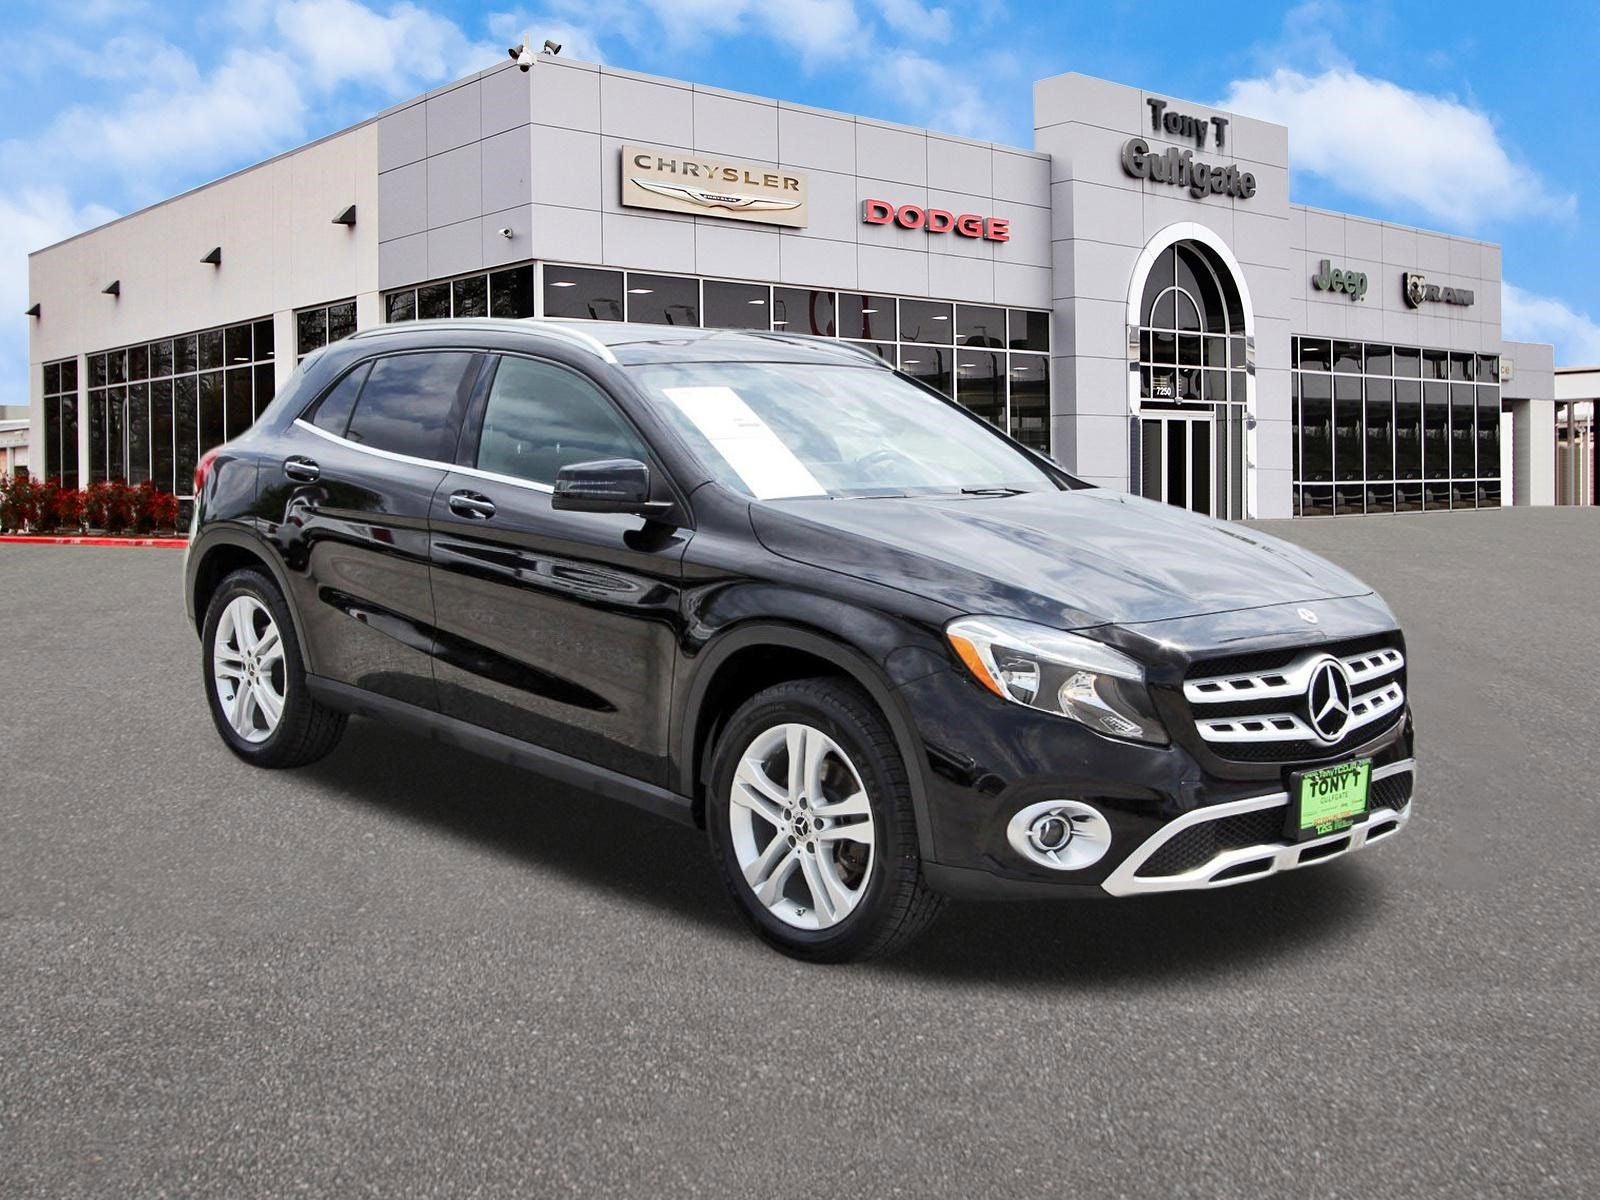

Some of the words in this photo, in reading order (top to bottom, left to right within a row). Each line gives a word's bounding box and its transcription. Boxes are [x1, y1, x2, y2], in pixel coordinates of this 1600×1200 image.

[1147, 98, 1208, 147] Tony
[1210, 116, 1229, 147] T
[634, 154, 800, 191] CHRYSLER
[1121, 138, 1257, 199] Gulfgate
[862, 199, 1010, 242] DODGE
[1312, 259, 1368, 301] Jeep
[1424, 283, 1475, 307] RAM
[1156, 386, 1172, 396] 7250
[1309, 772, 1349, 798] TONY
[1352, 768, 1361, 788] T
